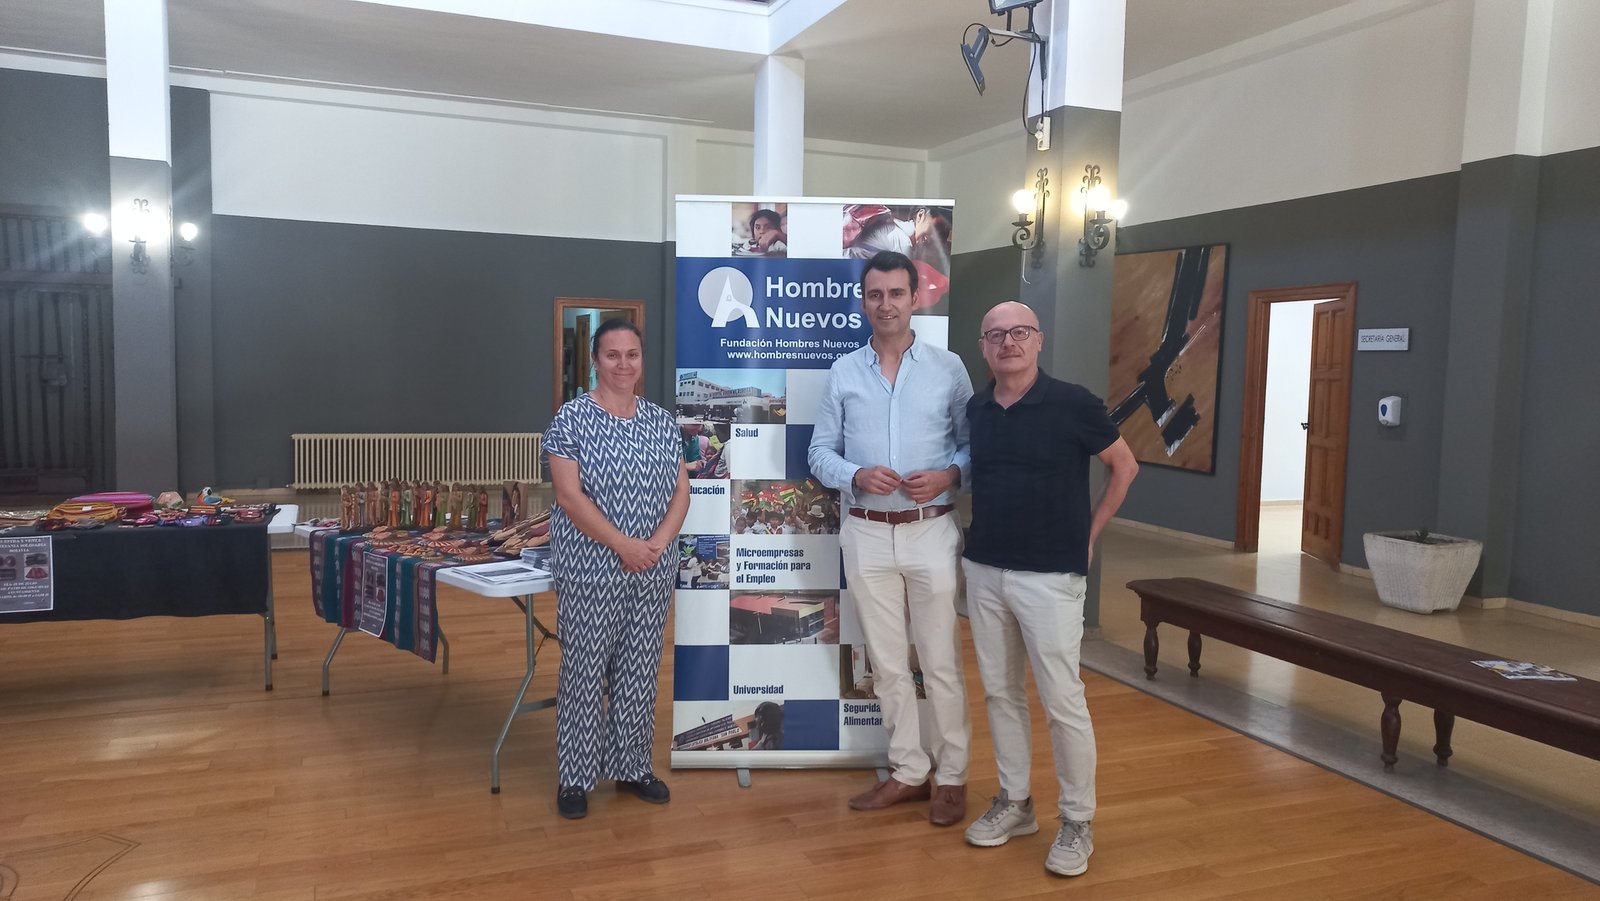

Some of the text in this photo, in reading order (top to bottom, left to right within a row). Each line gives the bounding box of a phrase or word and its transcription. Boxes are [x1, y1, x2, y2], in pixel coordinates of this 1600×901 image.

[766, 276, 863, 299] Hombre
[766, 307, 862, 329] Nuevos
[720, 338, 860, 349] Fundación Hombres Nuevos
[727, 350, 847, 360] www.hombresnuevos.o
[735, 427, 759, 438] Salud
[689, 484, 725, 495] ducación
[736, 547, 804, 559] Microempresas
[736, 560, 811, 571] y Formación para
[736, 574, 776, 585] el Empleo
[733, 684, 784, 695] Universidad
[843, 703, 881, 714] Segurida
[843, 716, 883, 726] Alimentar
